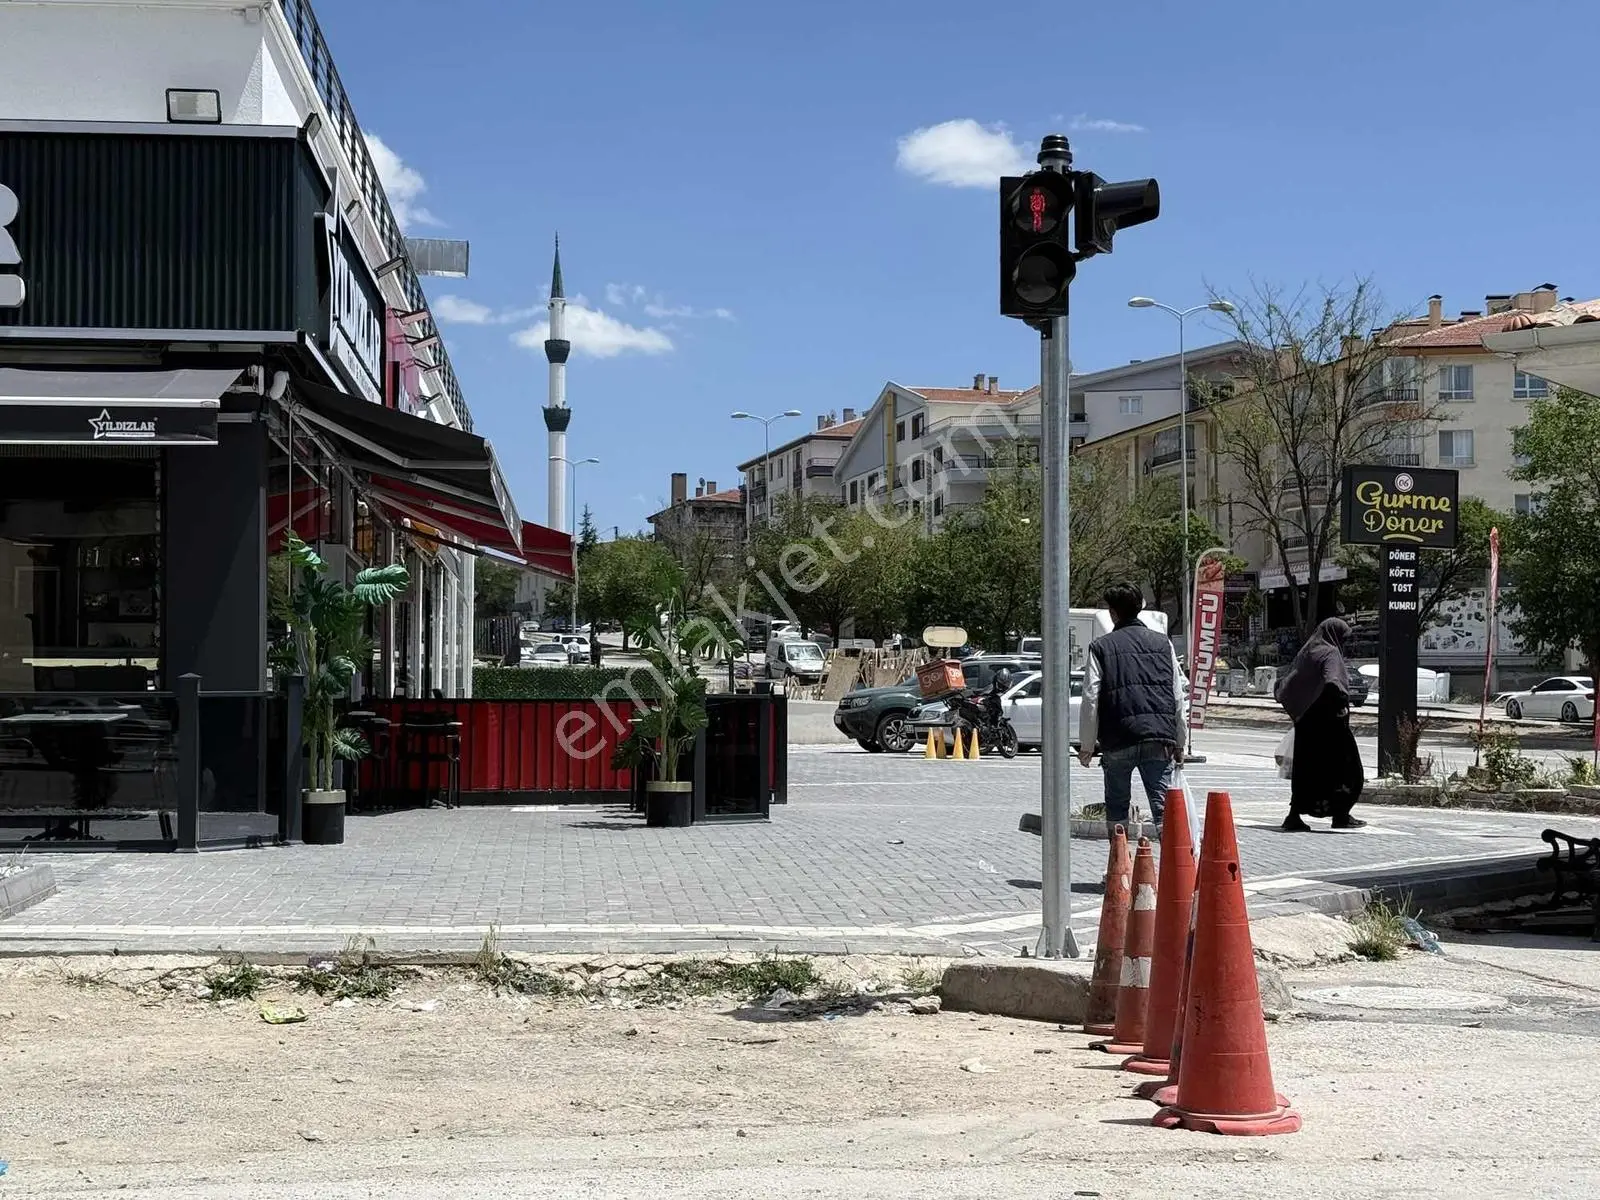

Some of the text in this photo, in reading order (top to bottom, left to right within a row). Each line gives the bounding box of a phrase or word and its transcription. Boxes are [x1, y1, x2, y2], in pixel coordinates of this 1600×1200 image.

[331, 234, 381, 389] YILDIZLAR
[97, 421, 156, 431] YILDIZLAR
[1356, 481, 1451, 512] Gurme
[1363, 509, 1444, 533] Döner
[1389, 549, 1416, 560] DÖNER
[1389, 566, 1415, 578] KÖFTE
[1392, 583, 1413, 592] TOST
[1389, 601, 1416, 610] KUMRU
